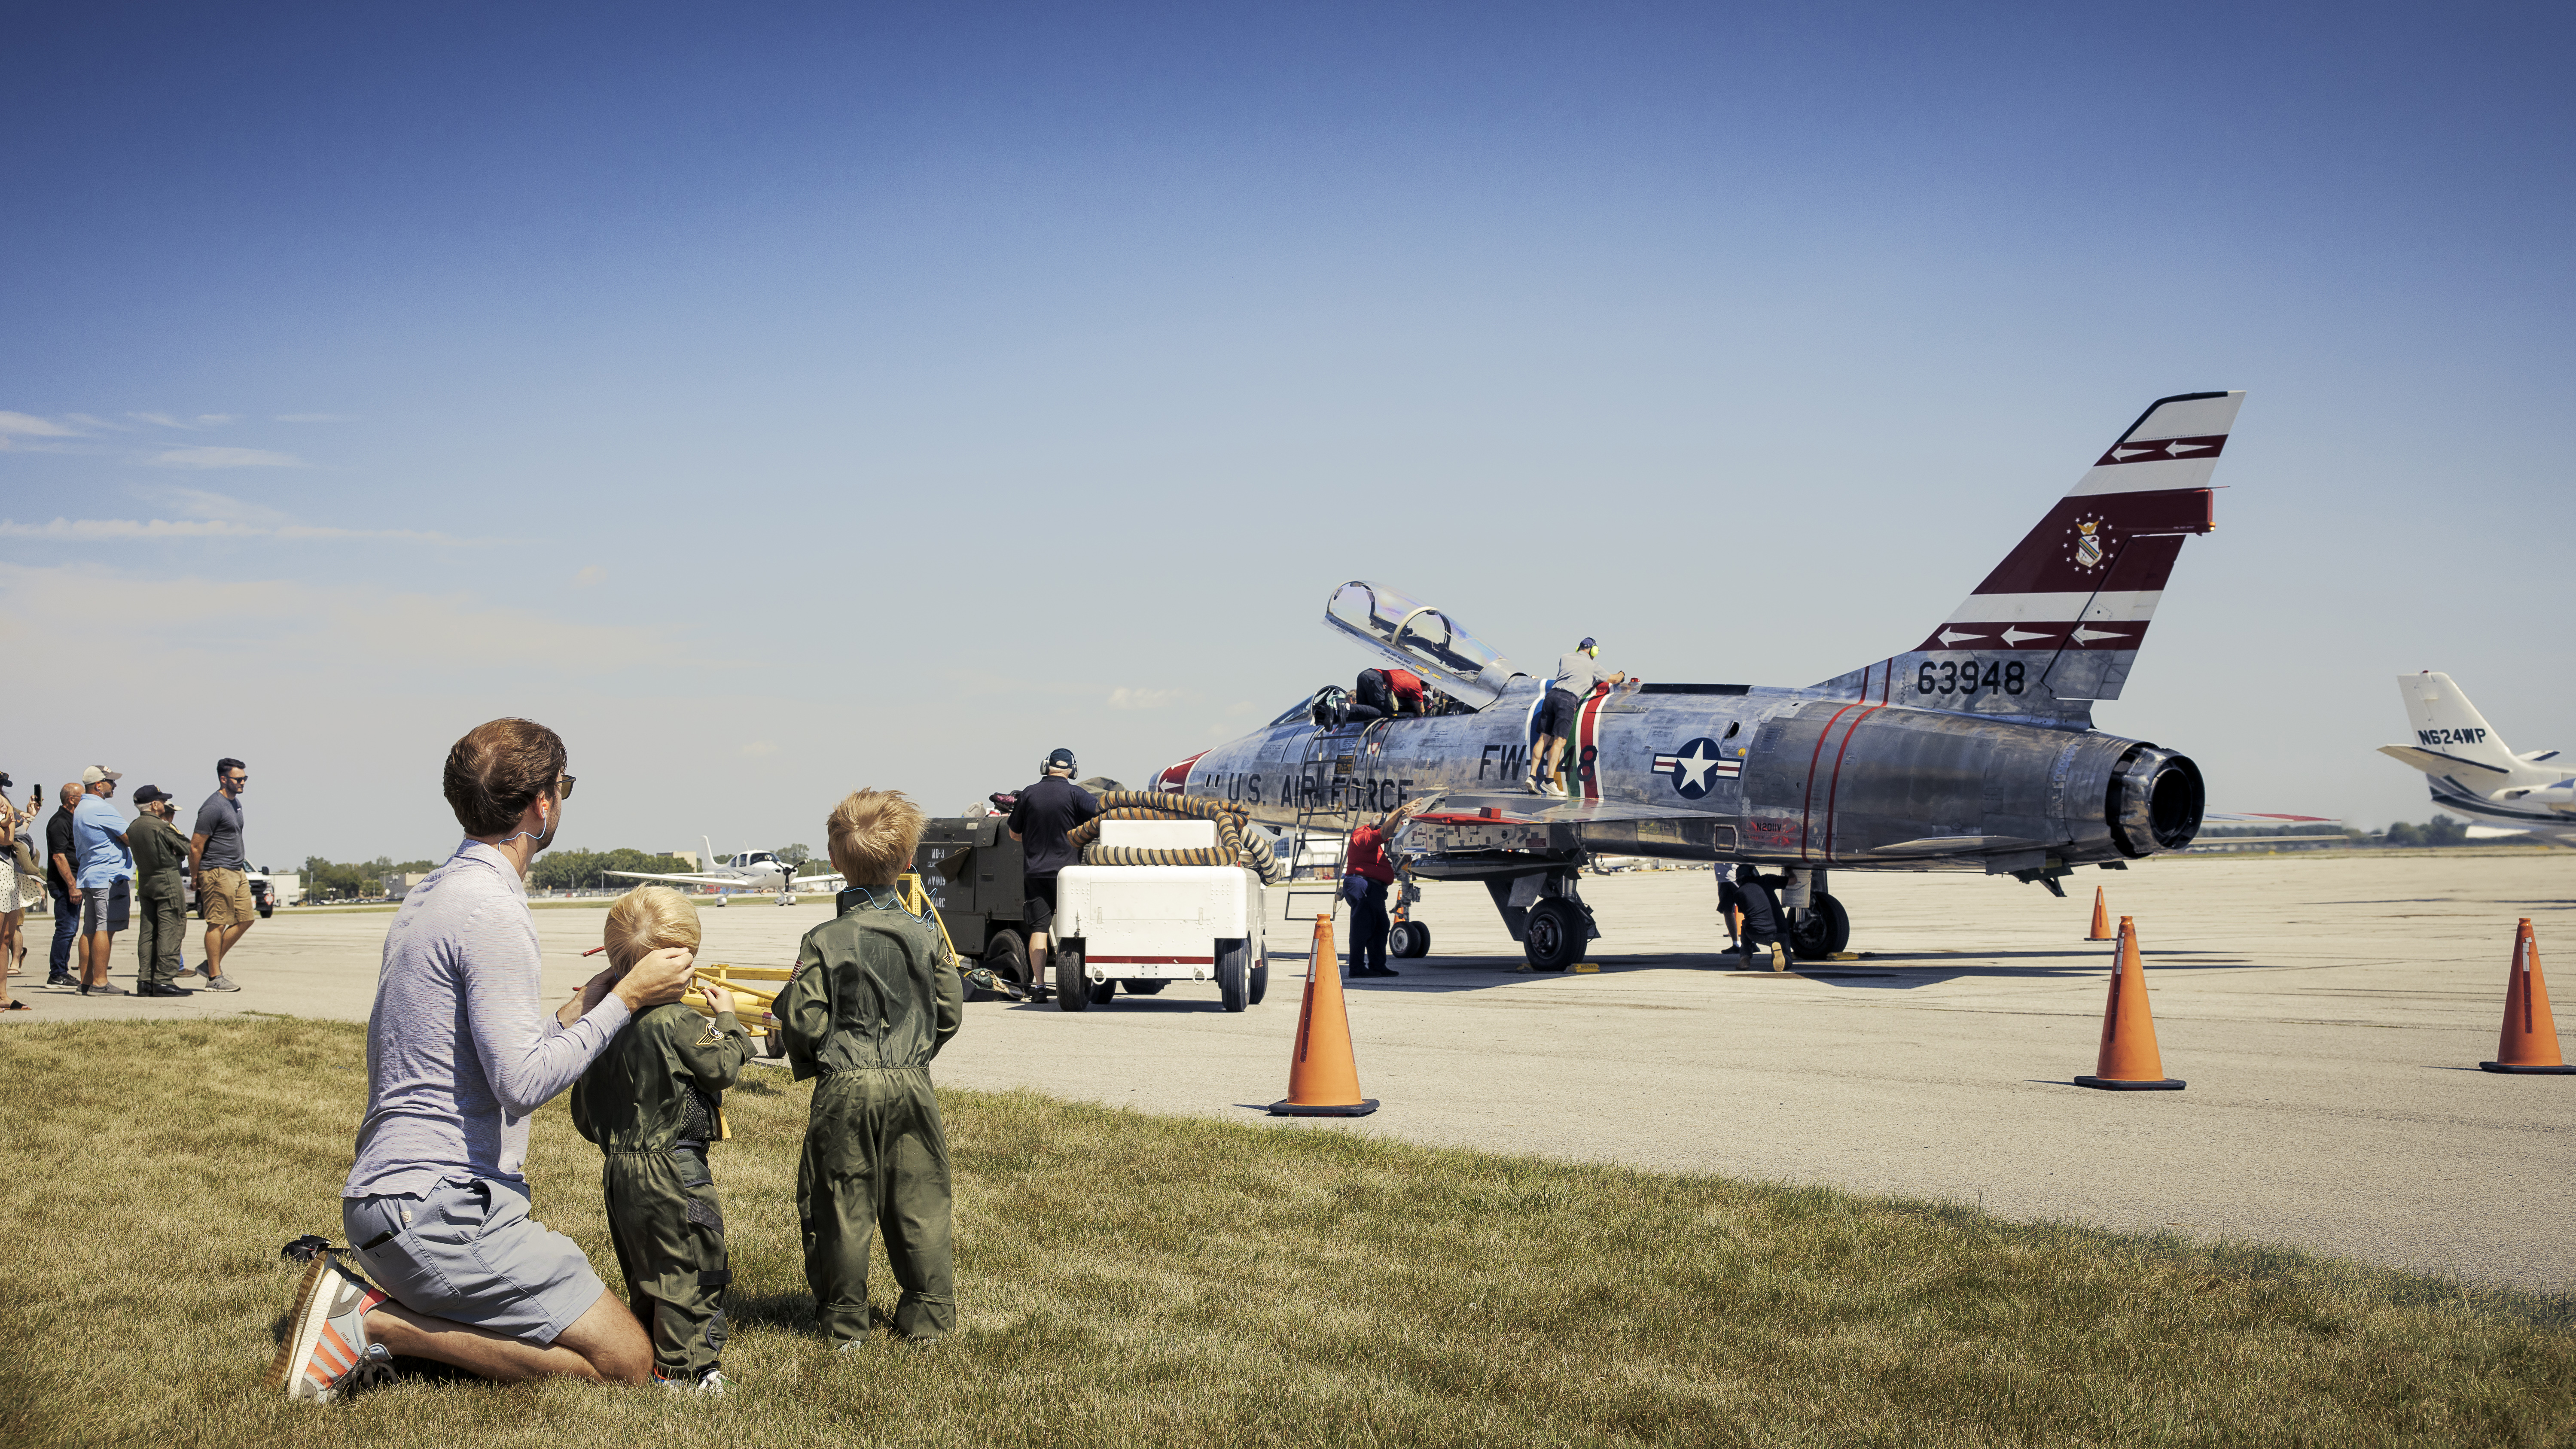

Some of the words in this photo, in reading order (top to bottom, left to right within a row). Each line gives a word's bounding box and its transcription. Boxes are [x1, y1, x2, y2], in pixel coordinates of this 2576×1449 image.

[1918, 661, 2025, 695] 63948
[2418, 728, 2486, 745] N624WP
[1228, 773, 1266, 806] U.S.
[1280, 775, 1316, 808] AIR
[1331, 777, 1414, 813] FORCE
[1756, 822, 1782, 832] N2011V
[340, 1332, 351, 1343] INIKI
